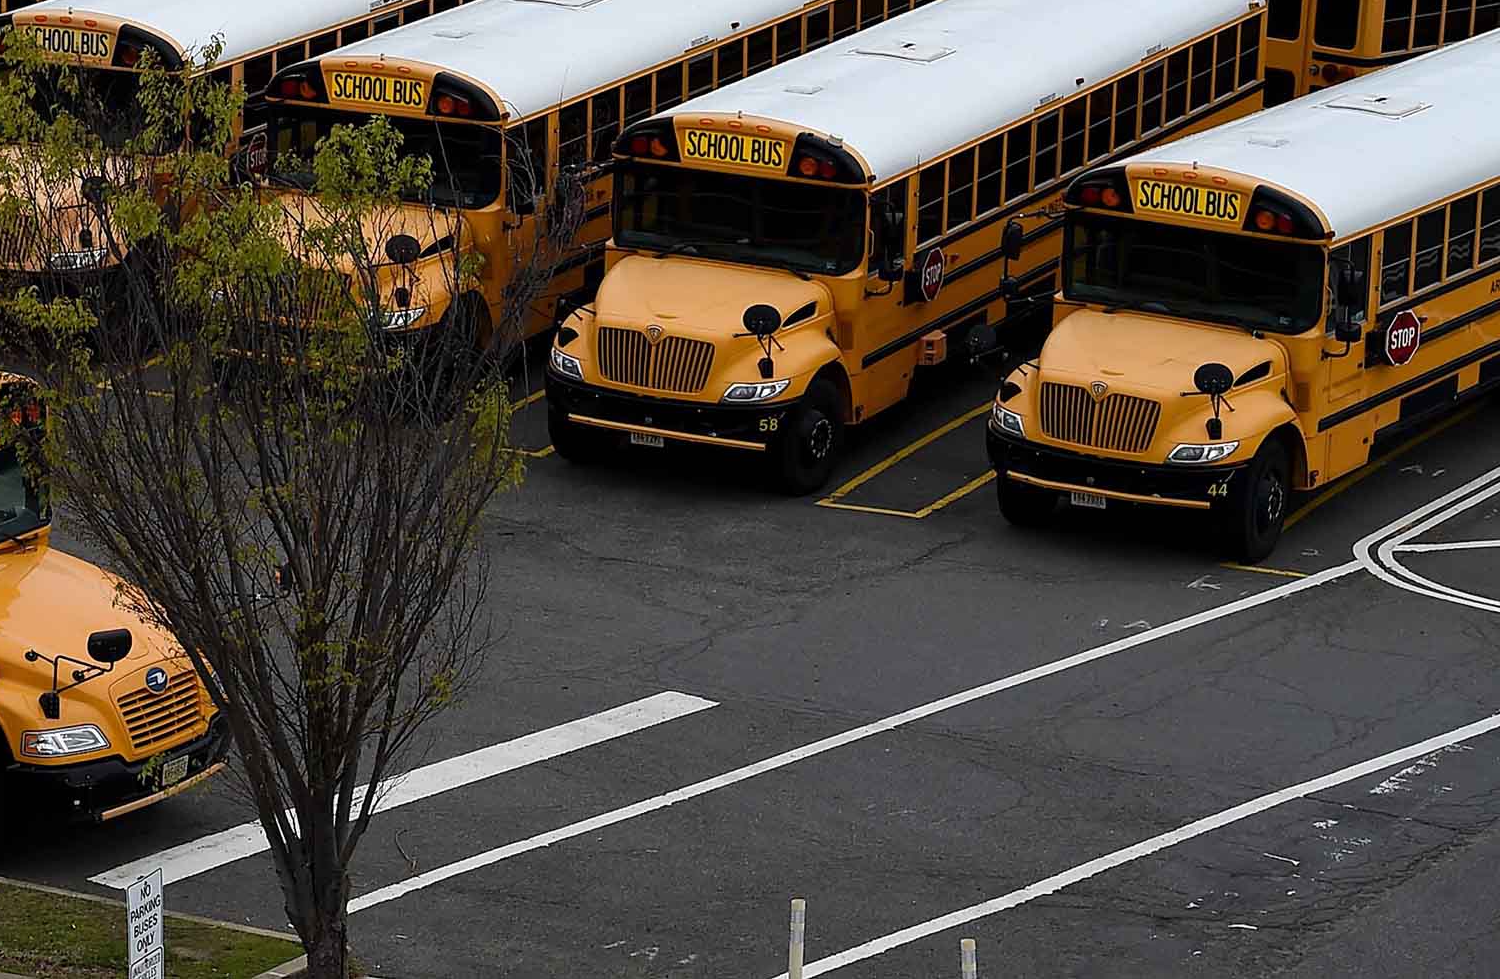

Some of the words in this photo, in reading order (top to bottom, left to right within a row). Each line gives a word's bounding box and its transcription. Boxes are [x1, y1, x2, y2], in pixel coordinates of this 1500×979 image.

[80, 30, 108, 57] BUS
[334, 73, 394, 103] SCHOOL
[394, 78, 423, 106] BUS
[686, 130, 749, 163] SCHOOL
[750, 138, 783, 167] BUS
[1139, 180, 1203, 215] SCHOOL
[1205, 187, 1239, 221] BUS
[1391, 326, 1415, 349] STOP
[759, 417, 779, 432] 58
[1207, 482, 1228, 497] 44
[140, 884, 151, 901] NO
[130, 894, 161, 923] PARKING
[133, 913, 158, 938] BUSES
[136, 931, 155, 952] ONLY
